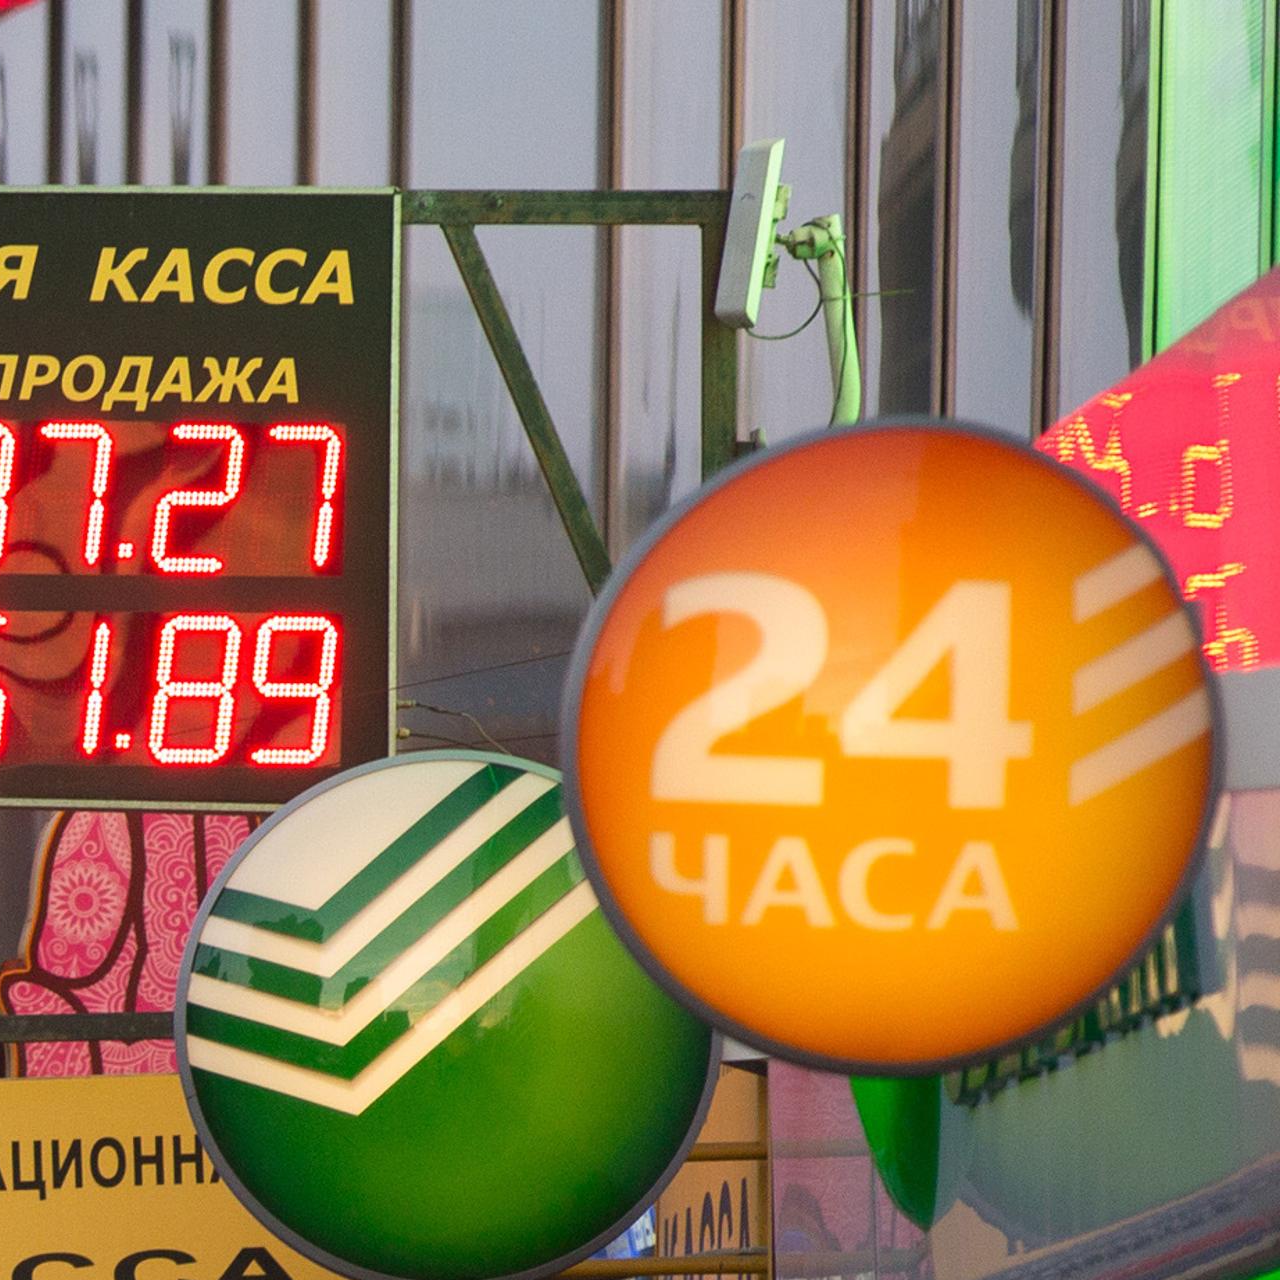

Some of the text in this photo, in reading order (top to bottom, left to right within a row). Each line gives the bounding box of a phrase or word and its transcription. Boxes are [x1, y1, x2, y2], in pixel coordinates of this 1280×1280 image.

[89, 247, 355, 305] КАССА
[651, 570, 1032, 808] 24
[649, 832, 1019, 932] ЧАСА
